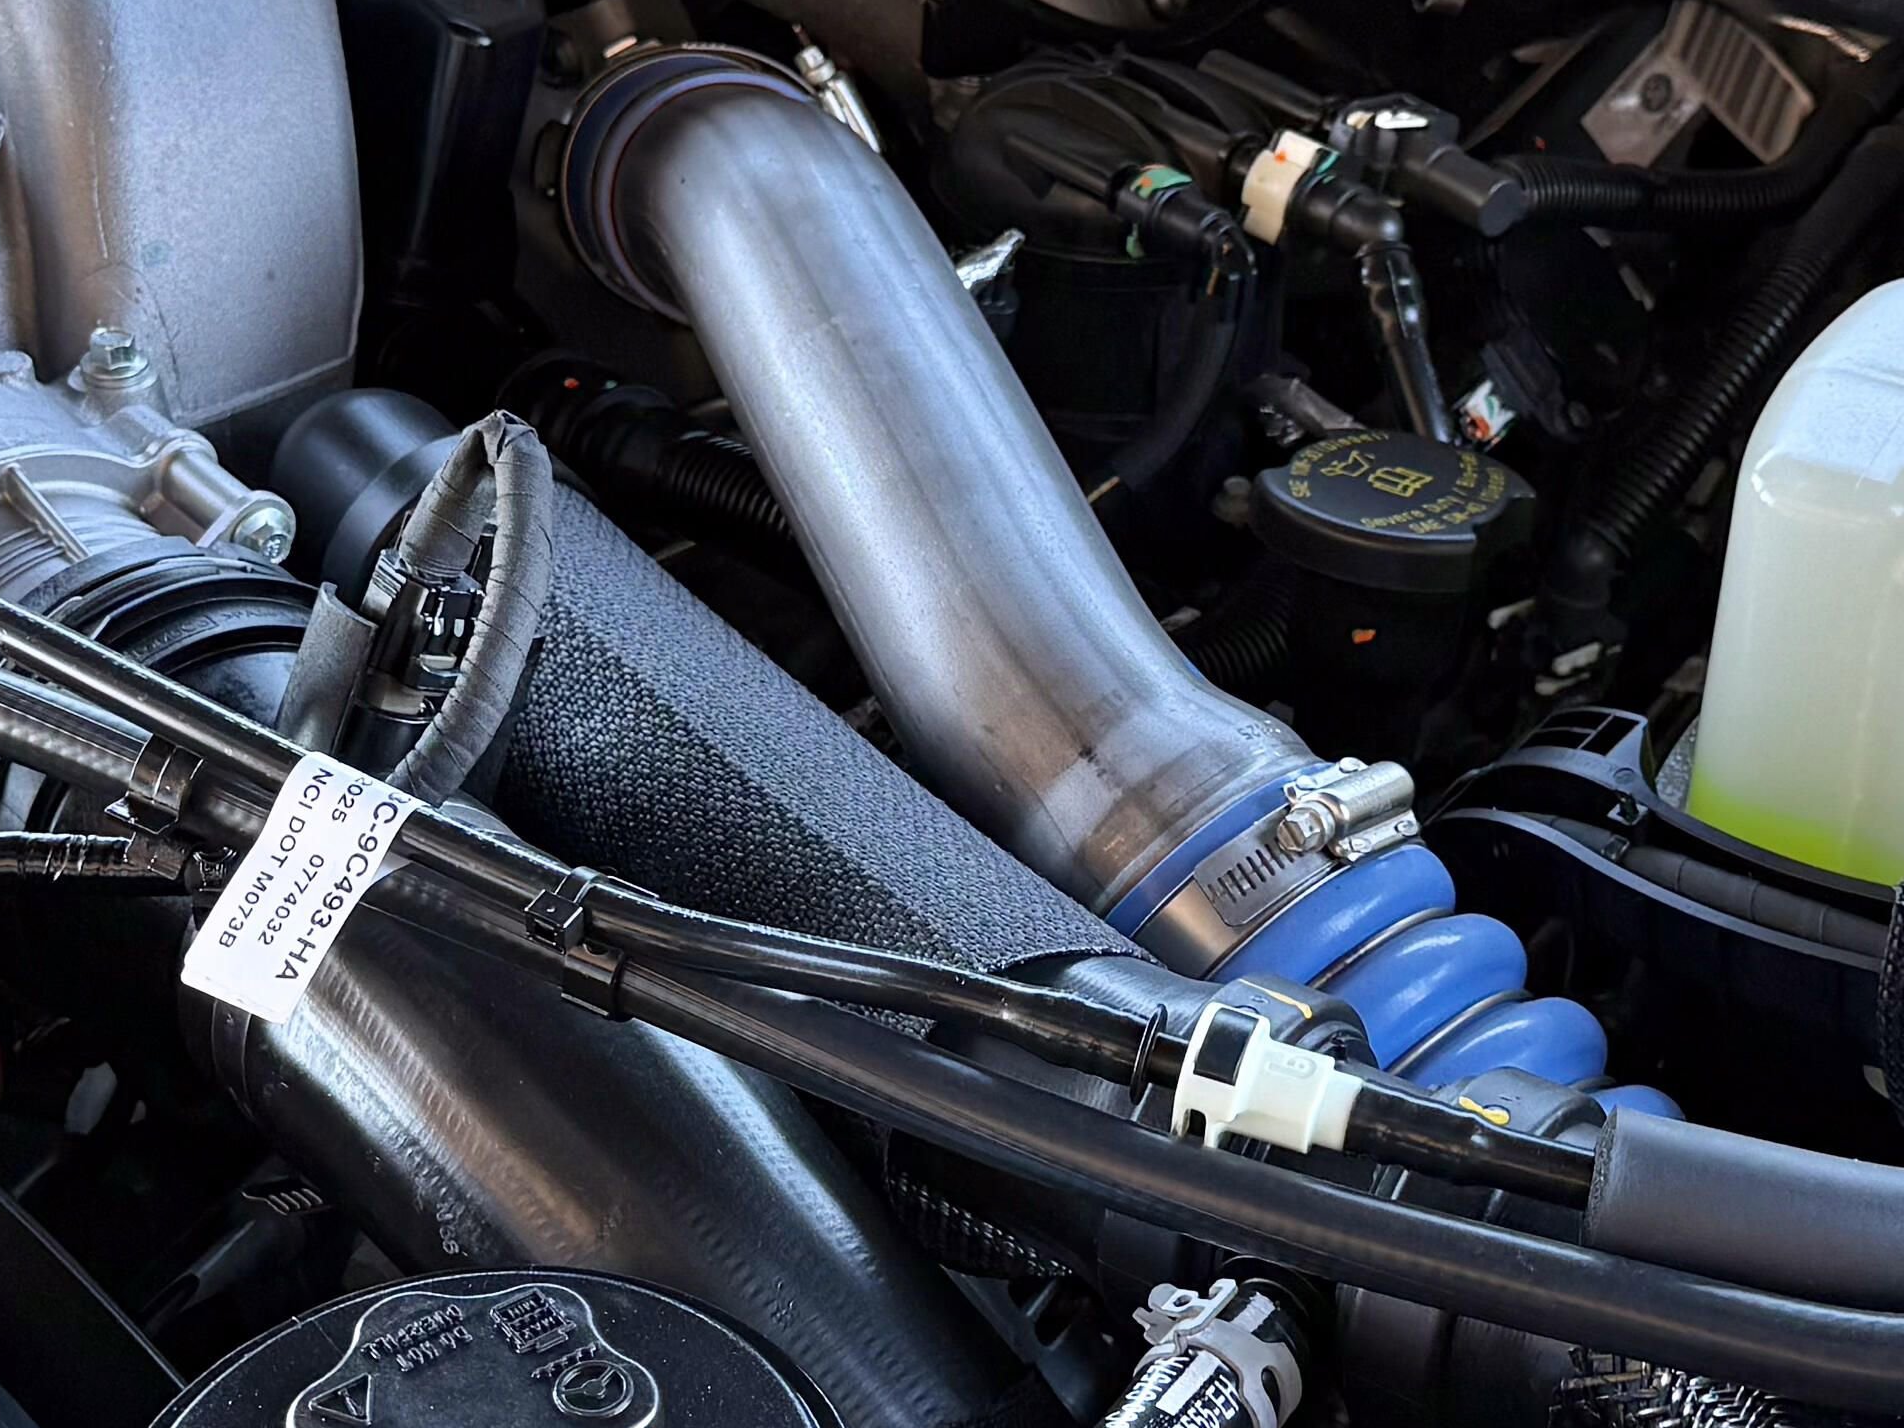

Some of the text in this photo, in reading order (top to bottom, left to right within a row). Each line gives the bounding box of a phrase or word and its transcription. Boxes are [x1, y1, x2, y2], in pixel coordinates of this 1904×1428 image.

[218, 767, 334, 948] NCI DOT M073B
[257, 777, 374, 945] 2025 0774032
